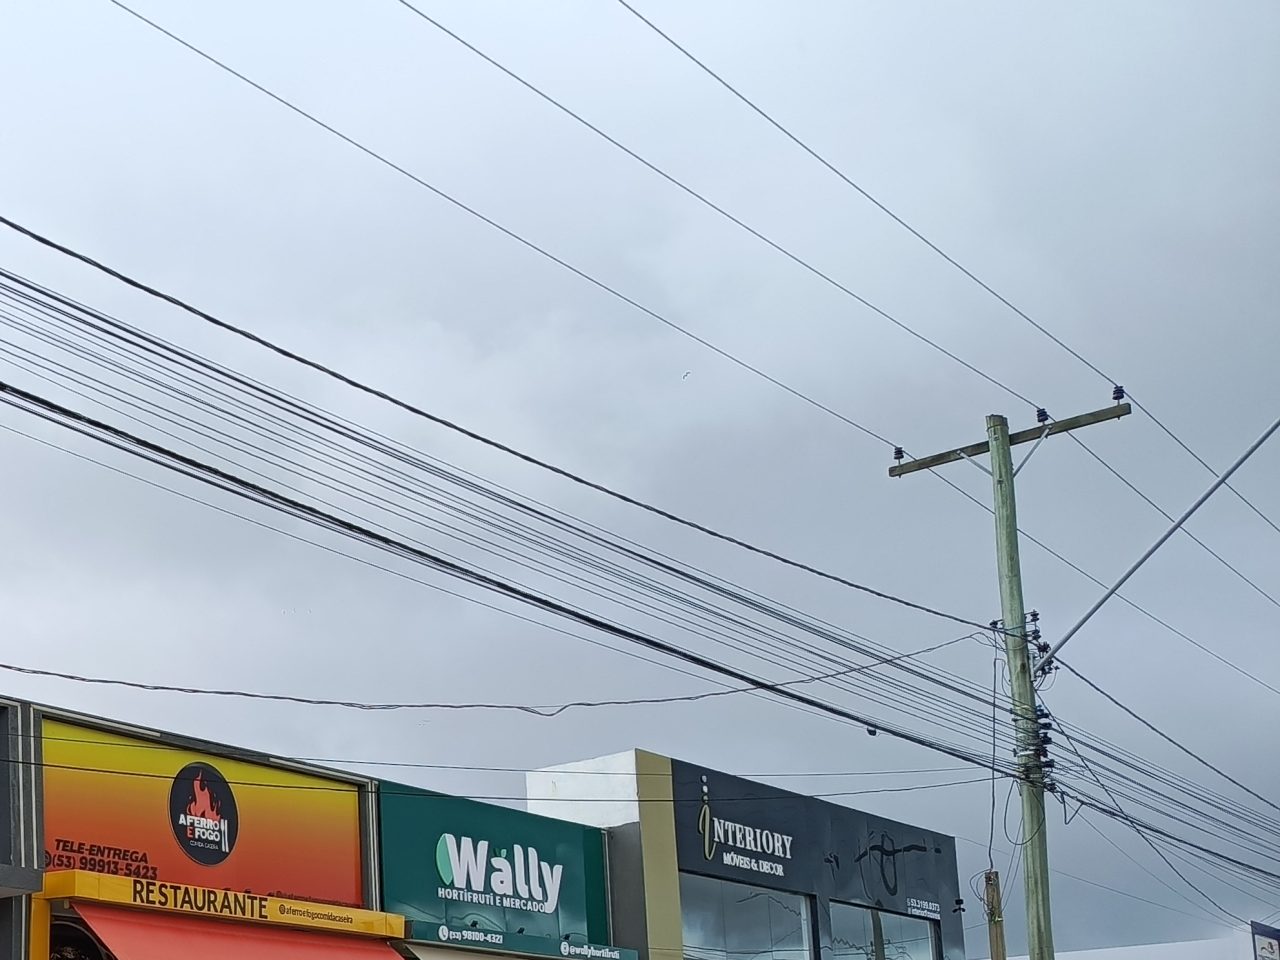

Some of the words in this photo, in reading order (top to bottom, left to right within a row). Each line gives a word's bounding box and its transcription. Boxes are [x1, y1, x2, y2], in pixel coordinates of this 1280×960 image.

[186, 815, 219, 831] FERRO
[187, 826, 194, 838] E
[195, 828, 221, 842] FOGO
[54, 838, 149, 865] TELE-ENTREGA
[52, 854, 77, 870] (53)
[79, 855, 158, 881] 99913-5423
[440, 832, 564, 914] Wally
[751, 858, 759, 872] &
[759, 860, 785, 877] DECOR
[132, 879, 269, 920] RESTAURANTE
[495, 896, 502, 908] E
[502, 897, 546, 914] MERCADO
